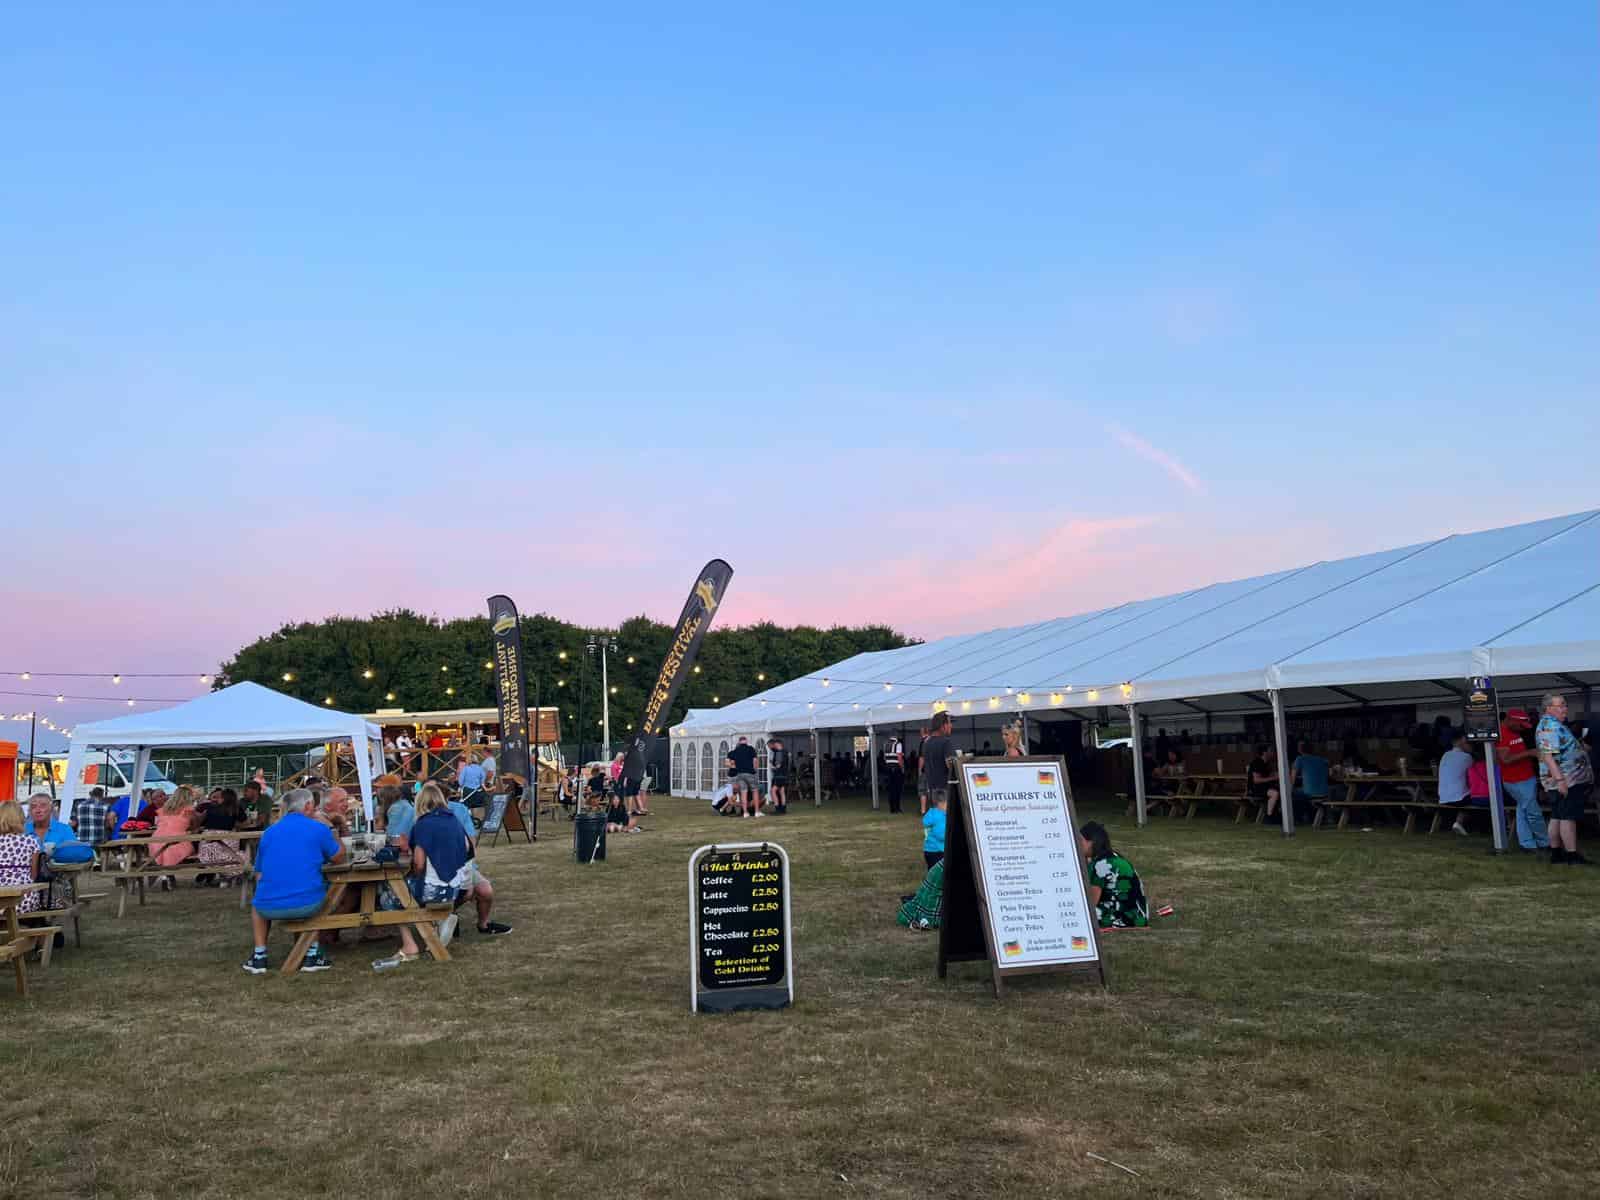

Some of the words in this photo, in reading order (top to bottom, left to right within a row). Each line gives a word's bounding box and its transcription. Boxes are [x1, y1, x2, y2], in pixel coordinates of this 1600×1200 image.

[662, 617, 701, 688] FESTIVAL
[975, 791, 1040, 803] BRATWURST
[1042, 790, 1057, 801] UK
[710, 862, 730, 872] Hot
[731, 861, 770, 871] Drinks
[702, 876, 734, 886] Coffee
[752, 873, 778, 883] £2.00
[703, 891, 729, 900] Latte
[703, 905, 749, 916] Cappuccino
[703, 922, 722, 931] Hot
[704, 931, 750, 942] Chocolate
[703, 948, 723, 957] Tea
[752, 943, 780, 953] £2.00
[713, 957, 758, 967] Selection
[713, 967, 735, 976] Cold
[738, 965, 771, 975] Drinks
